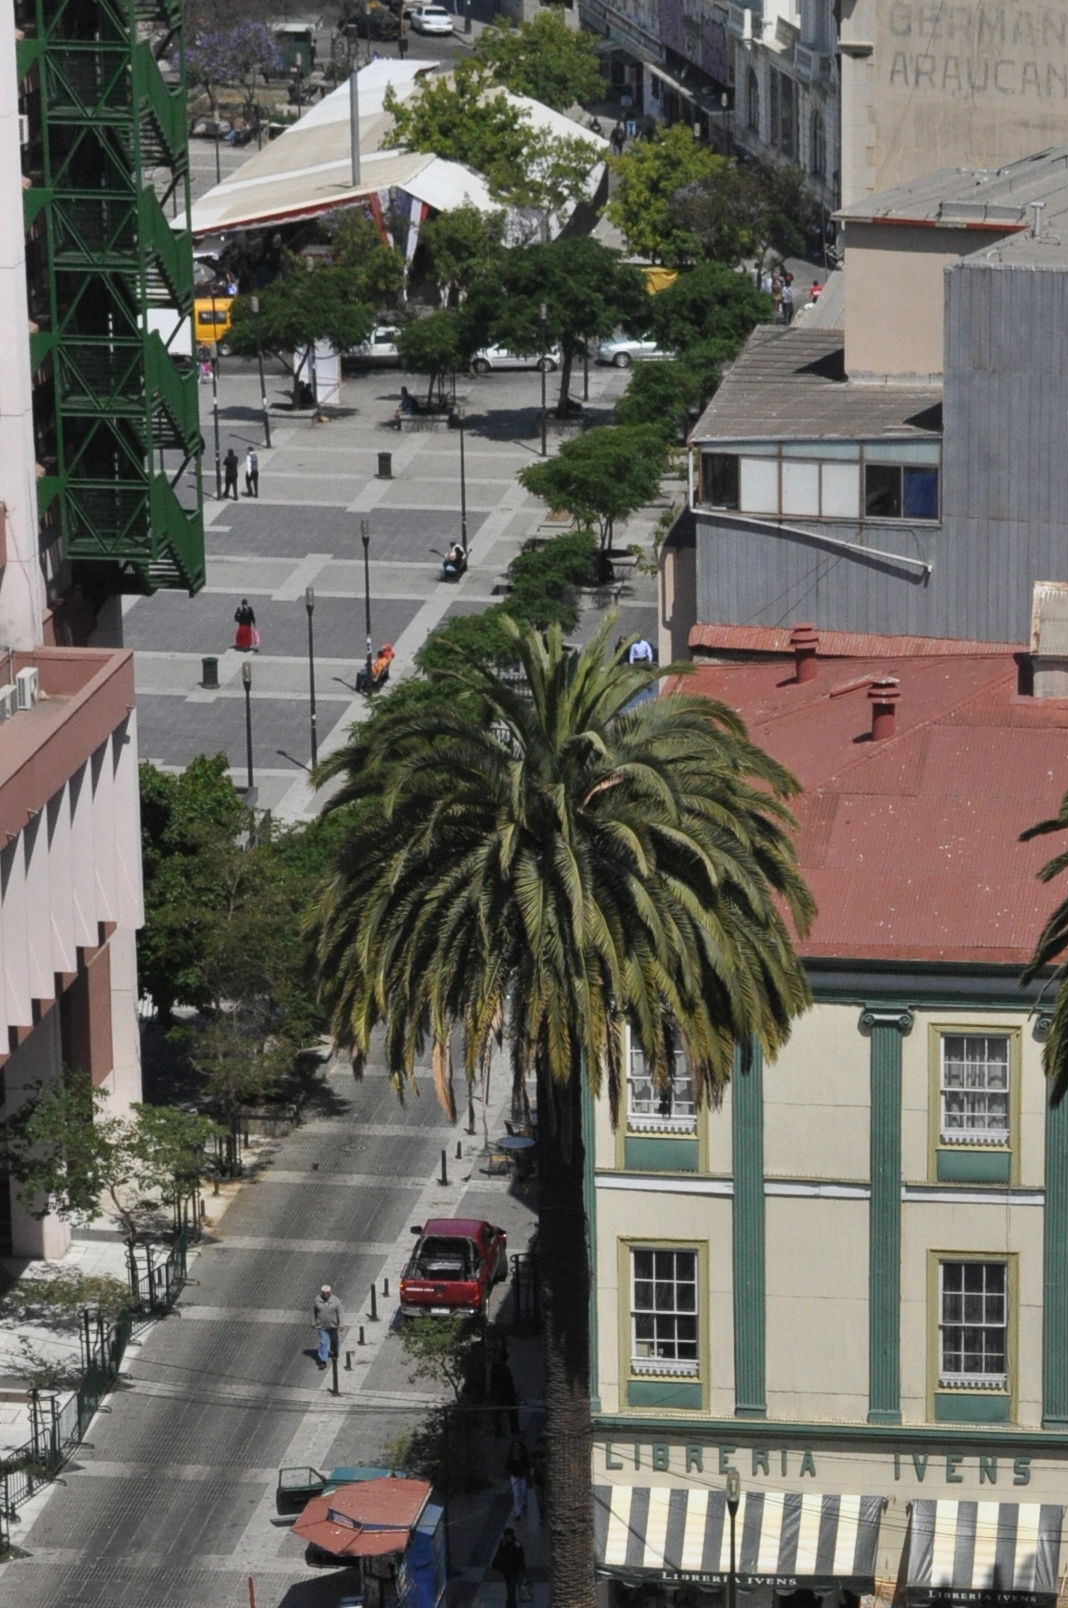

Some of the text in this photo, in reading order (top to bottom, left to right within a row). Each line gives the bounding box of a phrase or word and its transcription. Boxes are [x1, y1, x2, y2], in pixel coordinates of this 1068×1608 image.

[605, 1440, 1032, 1486] LIBRERIA IVENS
[748, 1577, 798, 1586] IVENS
[997, 1595, 1038, 1603] IVENS
